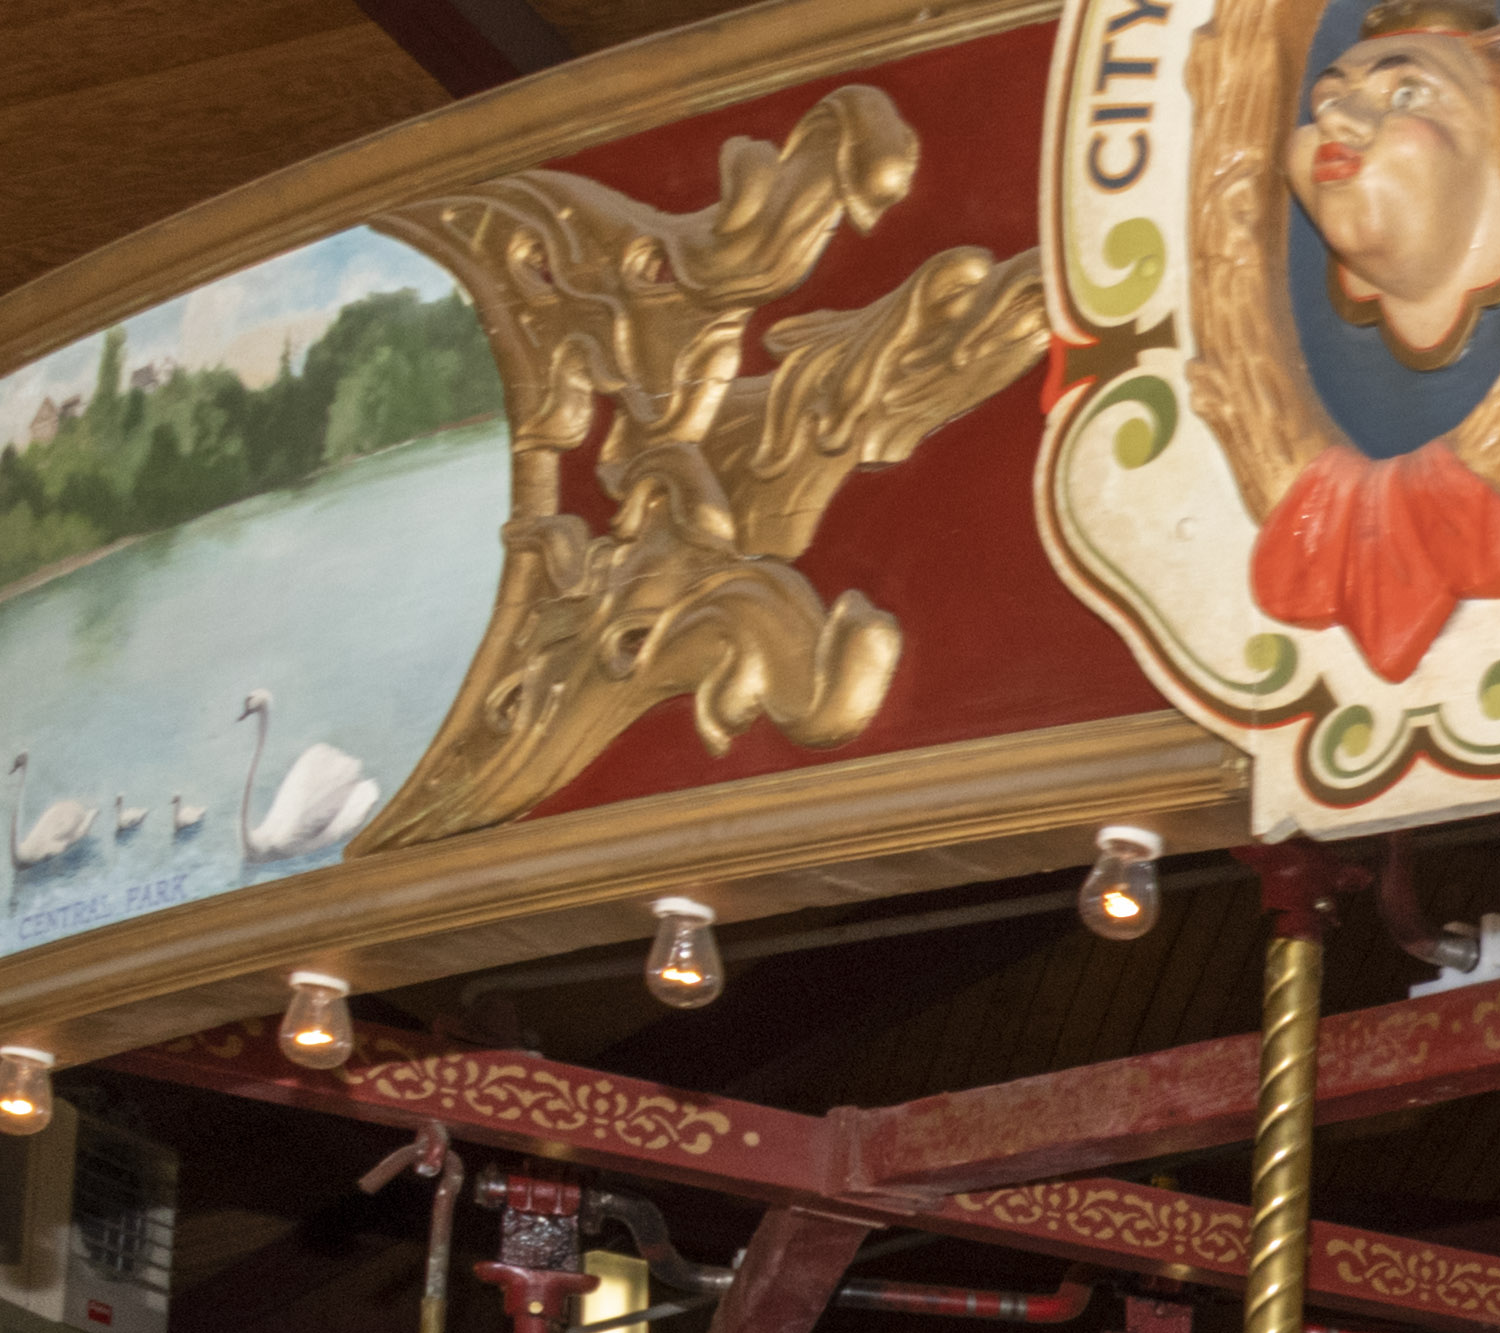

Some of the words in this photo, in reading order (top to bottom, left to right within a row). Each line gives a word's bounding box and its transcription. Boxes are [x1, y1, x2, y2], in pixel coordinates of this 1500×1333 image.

[1084, 0, 1174, 195] CITY
[18, 893, 113, 942] CENTRAL
[124, 873, 190, 914] PARK
